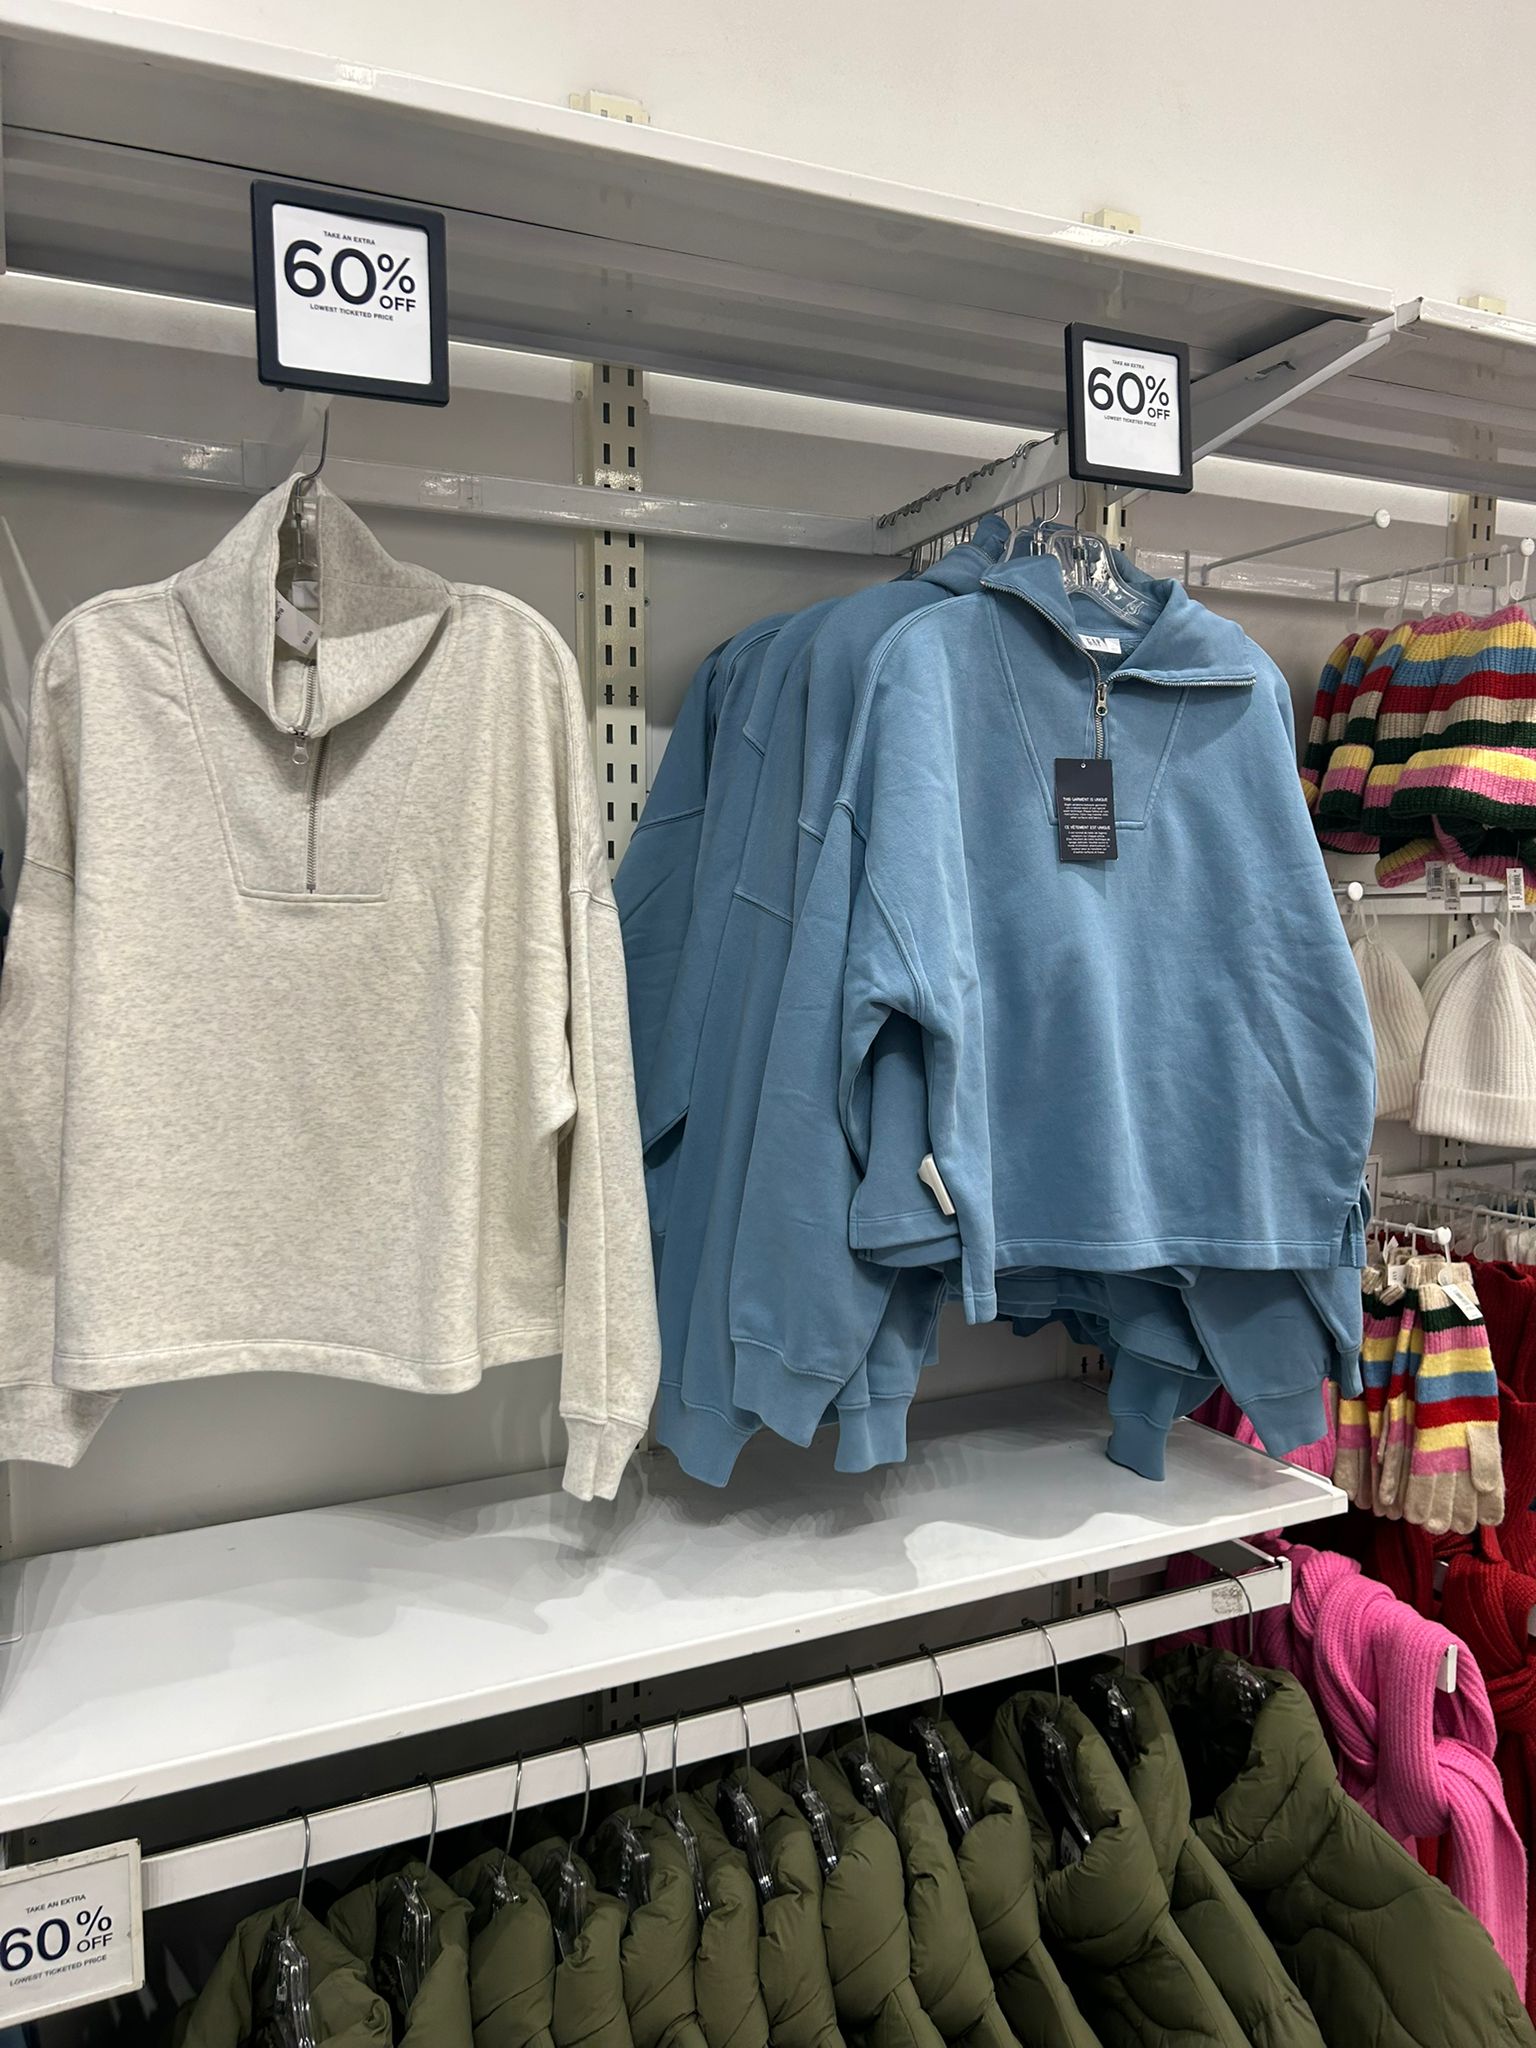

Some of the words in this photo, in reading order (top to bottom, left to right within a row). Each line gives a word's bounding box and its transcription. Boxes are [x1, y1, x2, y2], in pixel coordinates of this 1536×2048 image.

[323, 230, 341, 240] TAKE
[342, 233, 352, 241] AN
[353, 236, 376, 246] EXTRA
[284, 239, 416, 305] 60%
[310, 303, 337, 314] LOWEST
[339, 307, 372, 319] TICKETED
[373, 312, 394, 322] PRICE
[379, 295, 416, 312] OFF
[1088, 366, 1169, 415] 60%
[1122, 417, 1143, 425] TICKETED
[1147, 407, 1171, 420] OFF
[25, 1904, 45, 1914] TAKE
[47, 1901, 59, 1909] AN
[61, 1894, 86, 1905] EXTRA
[0, 1904, 112, 1972] 60%
[76, 1932, 113, 1953] OFF
[9, 1972, 43, 1987] LOWEST
[44, 1962, 82, 1977] TICKETED
[83, 1954, 107, 1967] PRICE
